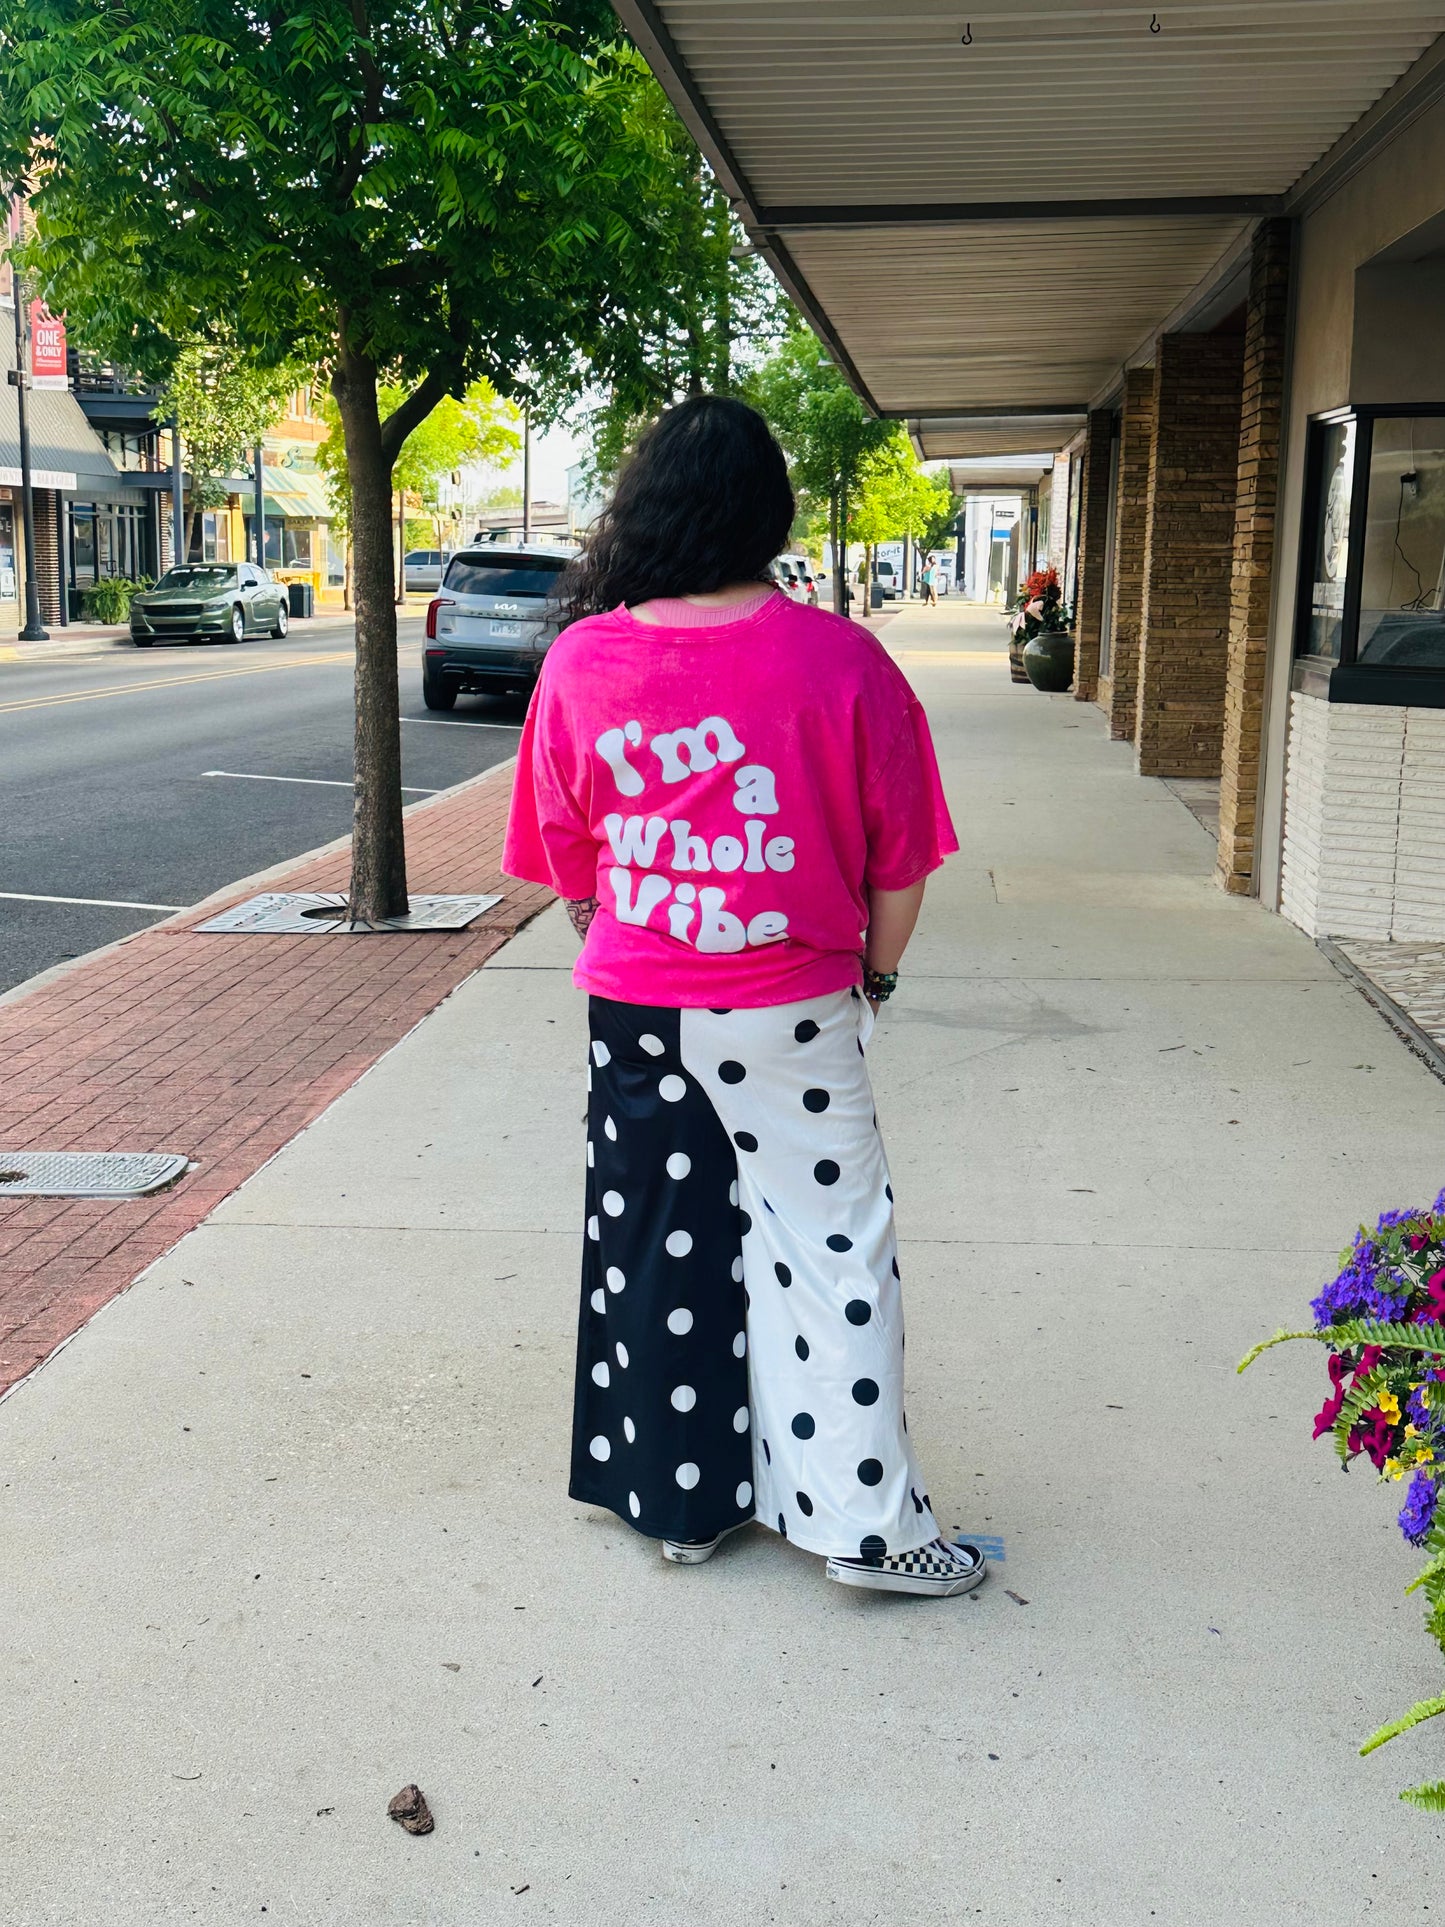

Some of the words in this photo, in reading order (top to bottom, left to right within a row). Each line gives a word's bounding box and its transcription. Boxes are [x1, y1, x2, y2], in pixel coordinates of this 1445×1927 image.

[36, 329, 61, 346] ONE
[595, 716, 746, 797] I'm
[732, 764, 780, 815] a
[604, 813, 796, 873] Whole
[609, 866, 790, 954] Vibe
